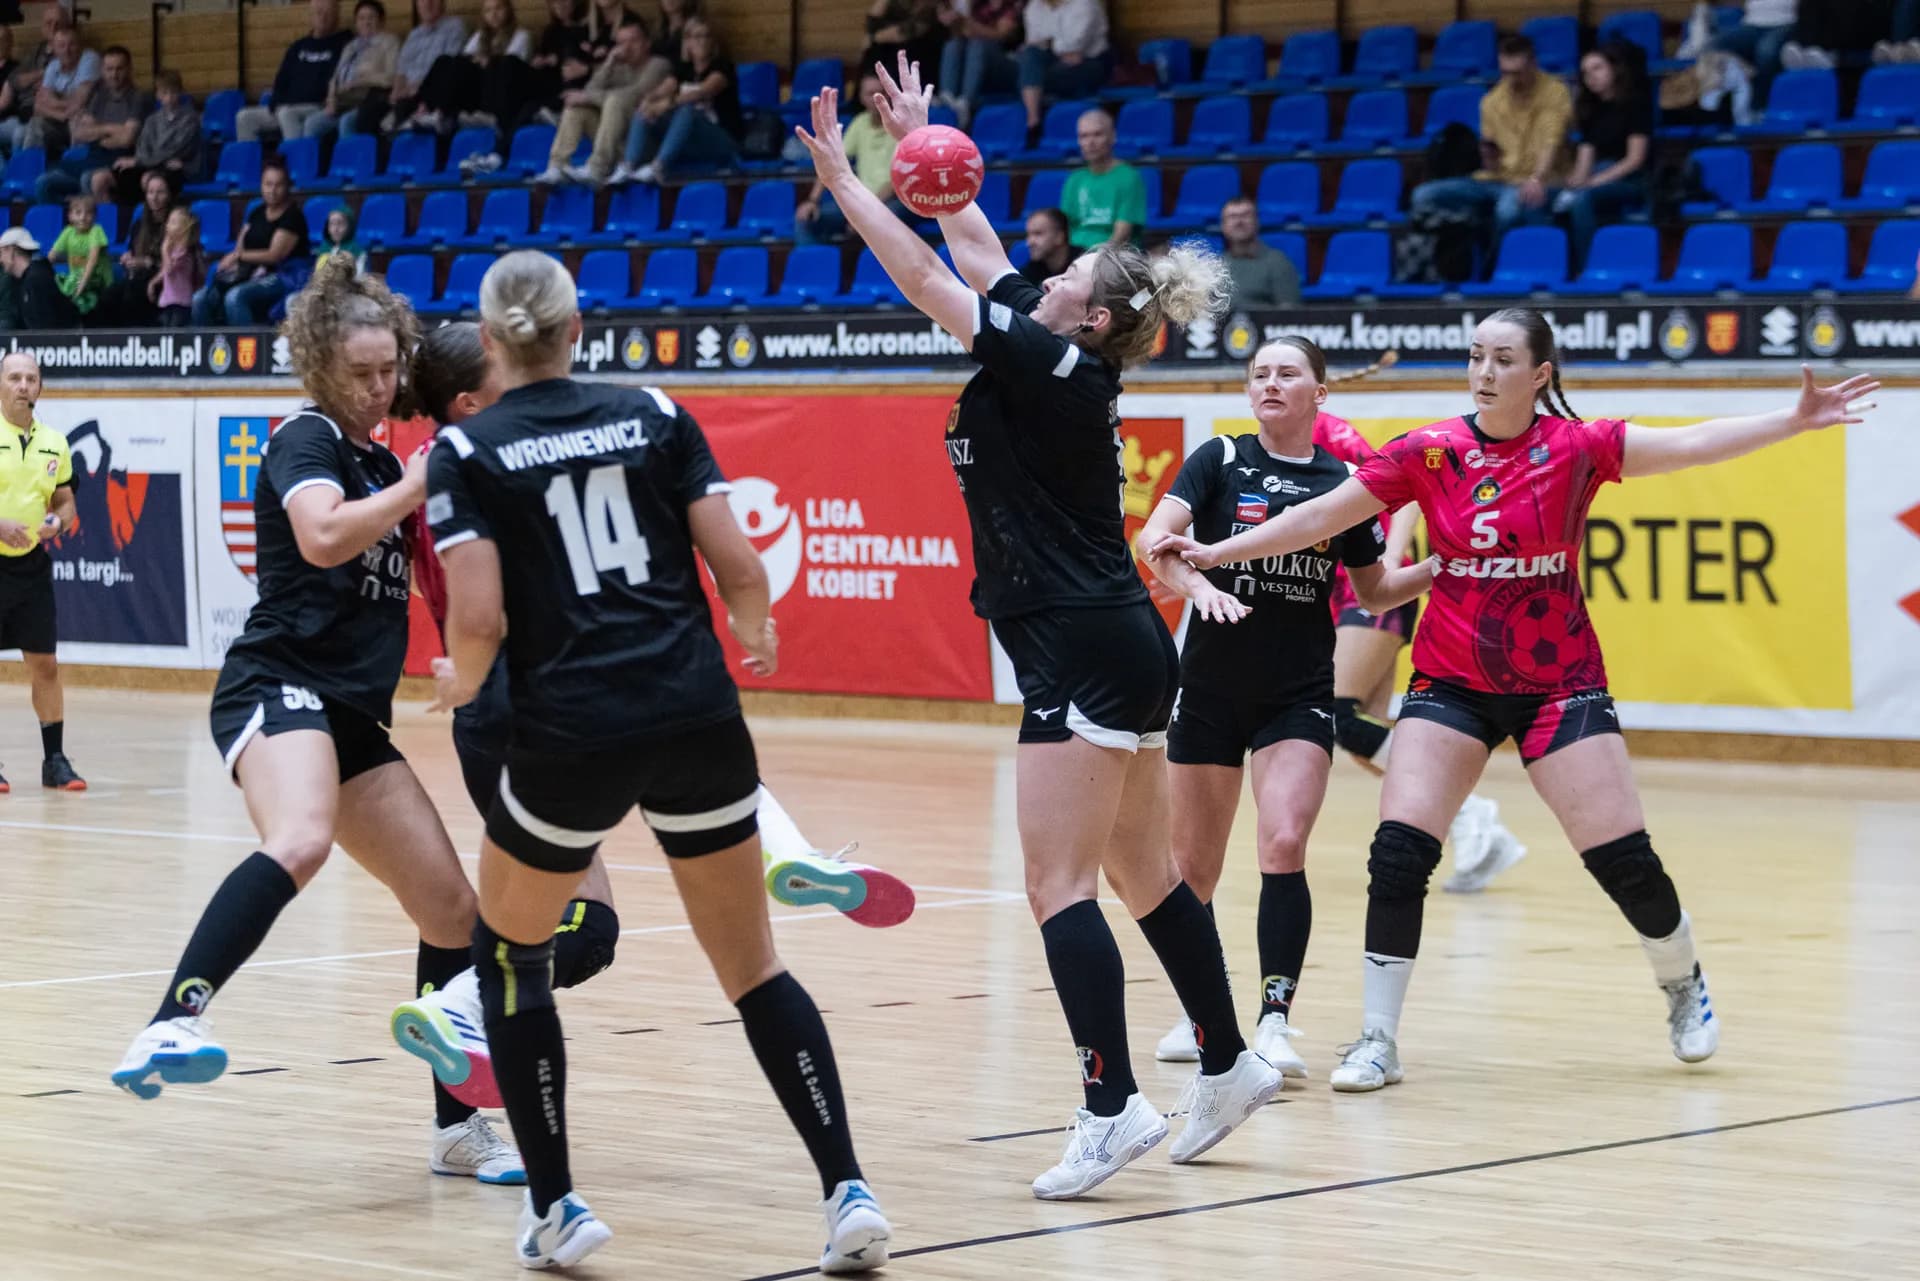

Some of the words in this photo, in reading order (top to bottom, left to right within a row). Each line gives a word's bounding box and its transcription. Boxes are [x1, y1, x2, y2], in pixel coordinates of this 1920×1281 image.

[912, 190, 969, 206] molten
[496, 418, 649, 471] WRONIEWICZ
[805, 497, 865, 529] LIGA
[544, 463, 651, 596] 14
[1470, 510, 1500, 550] 5
[805, 533, 960, 567] CENTRALNA
[1447, 551, 1567, 579] SUZUKI
[52, 559, 75, 581] na
[806, 568, 898, 600] KOBIET
[1262, 553, 1333, 583] OLKUSZ
